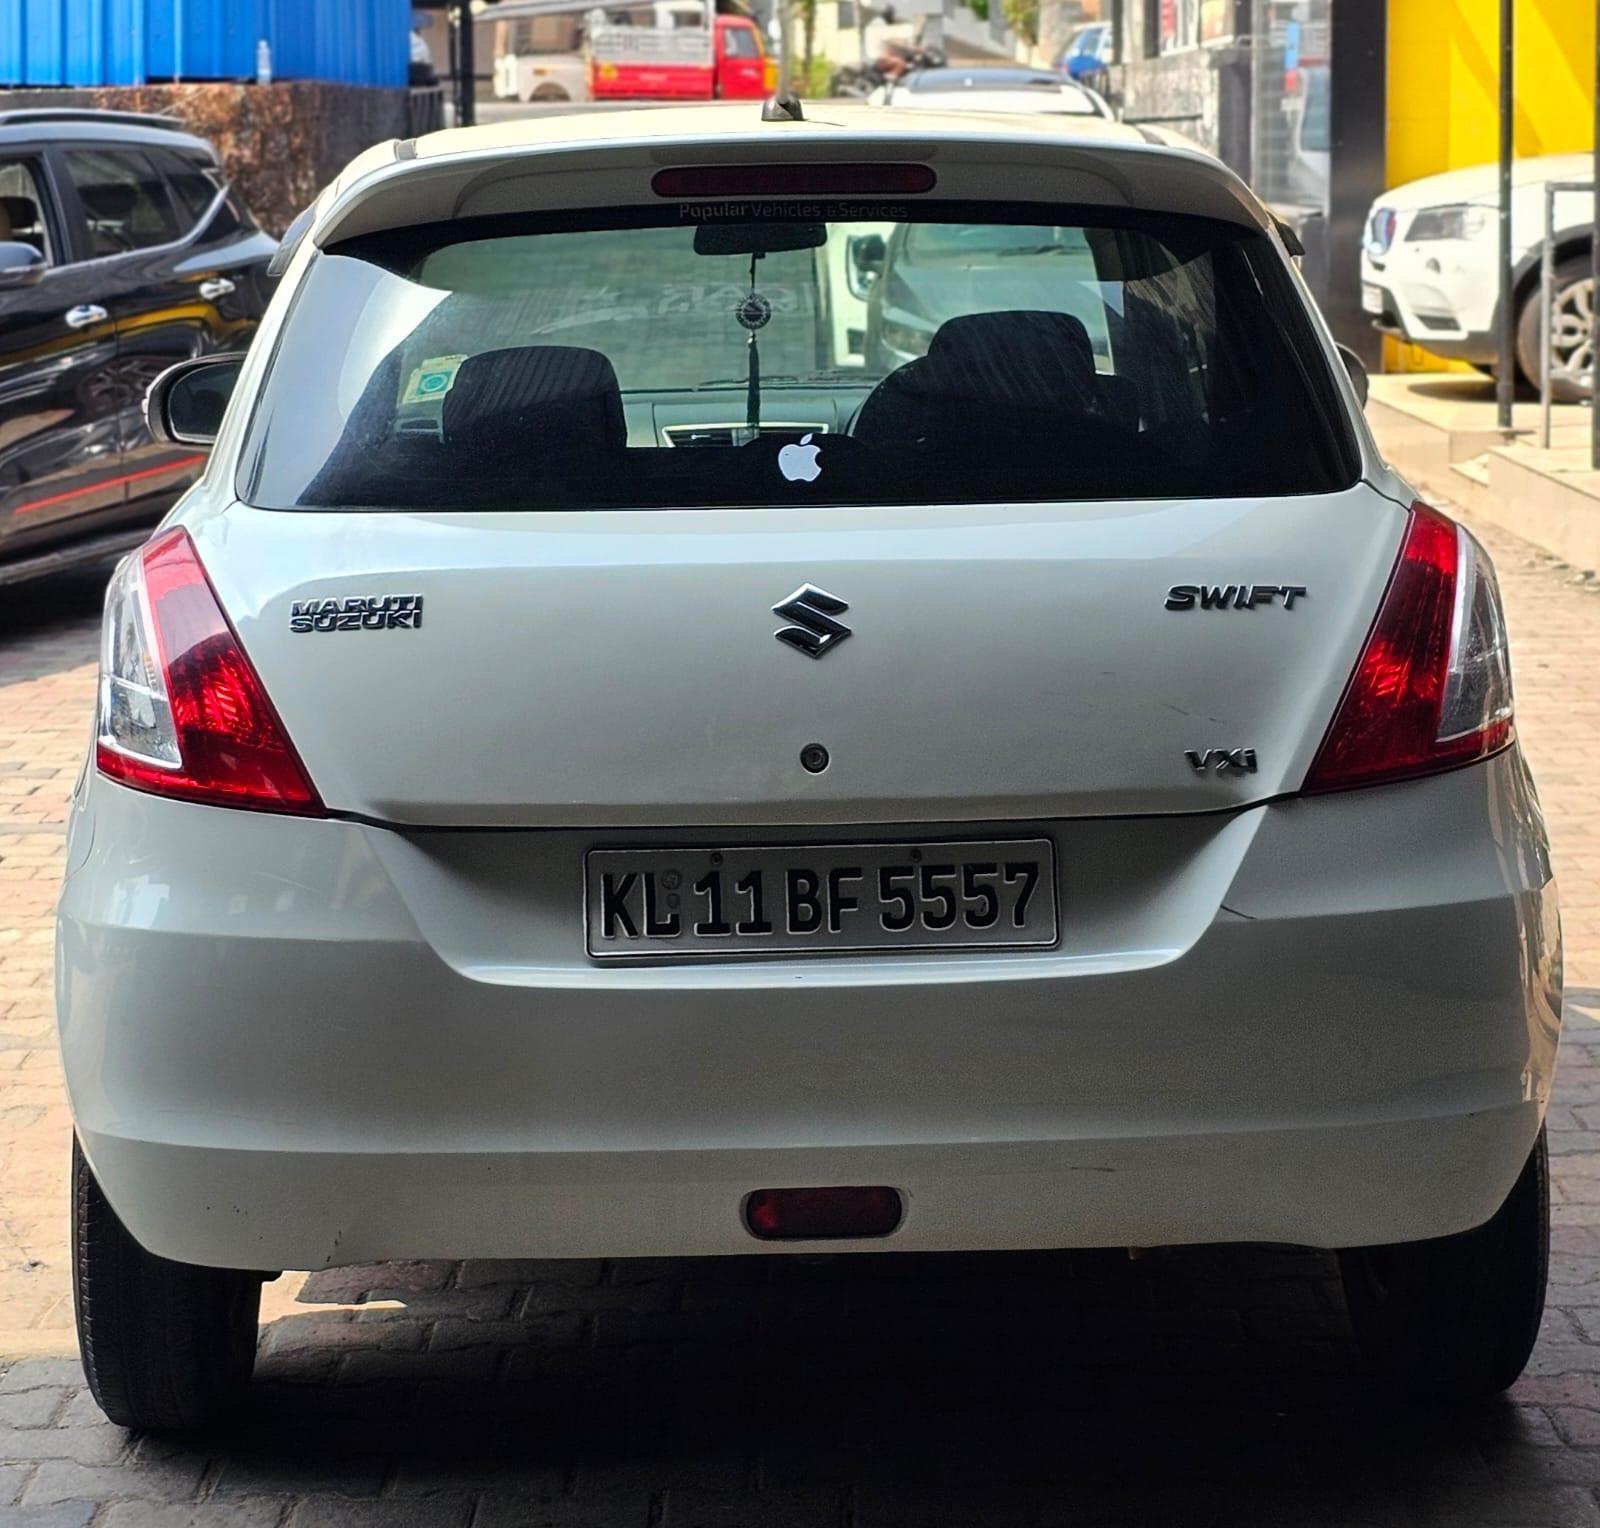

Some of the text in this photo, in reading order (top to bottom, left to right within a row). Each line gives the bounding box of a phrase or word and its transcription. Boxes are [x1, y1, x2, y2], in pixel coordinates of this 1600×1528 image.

[680, 203, 747, 221] Popular
[750, 202, 821, 217] Vehicles
[291, 593, 423, 617] MARUTI
[1164, 584, 1307, 611] SWIFT
[289, 610, 422, 632] SUZUKI
[601, 862, 1040, 938] KL 11 BF 5557
